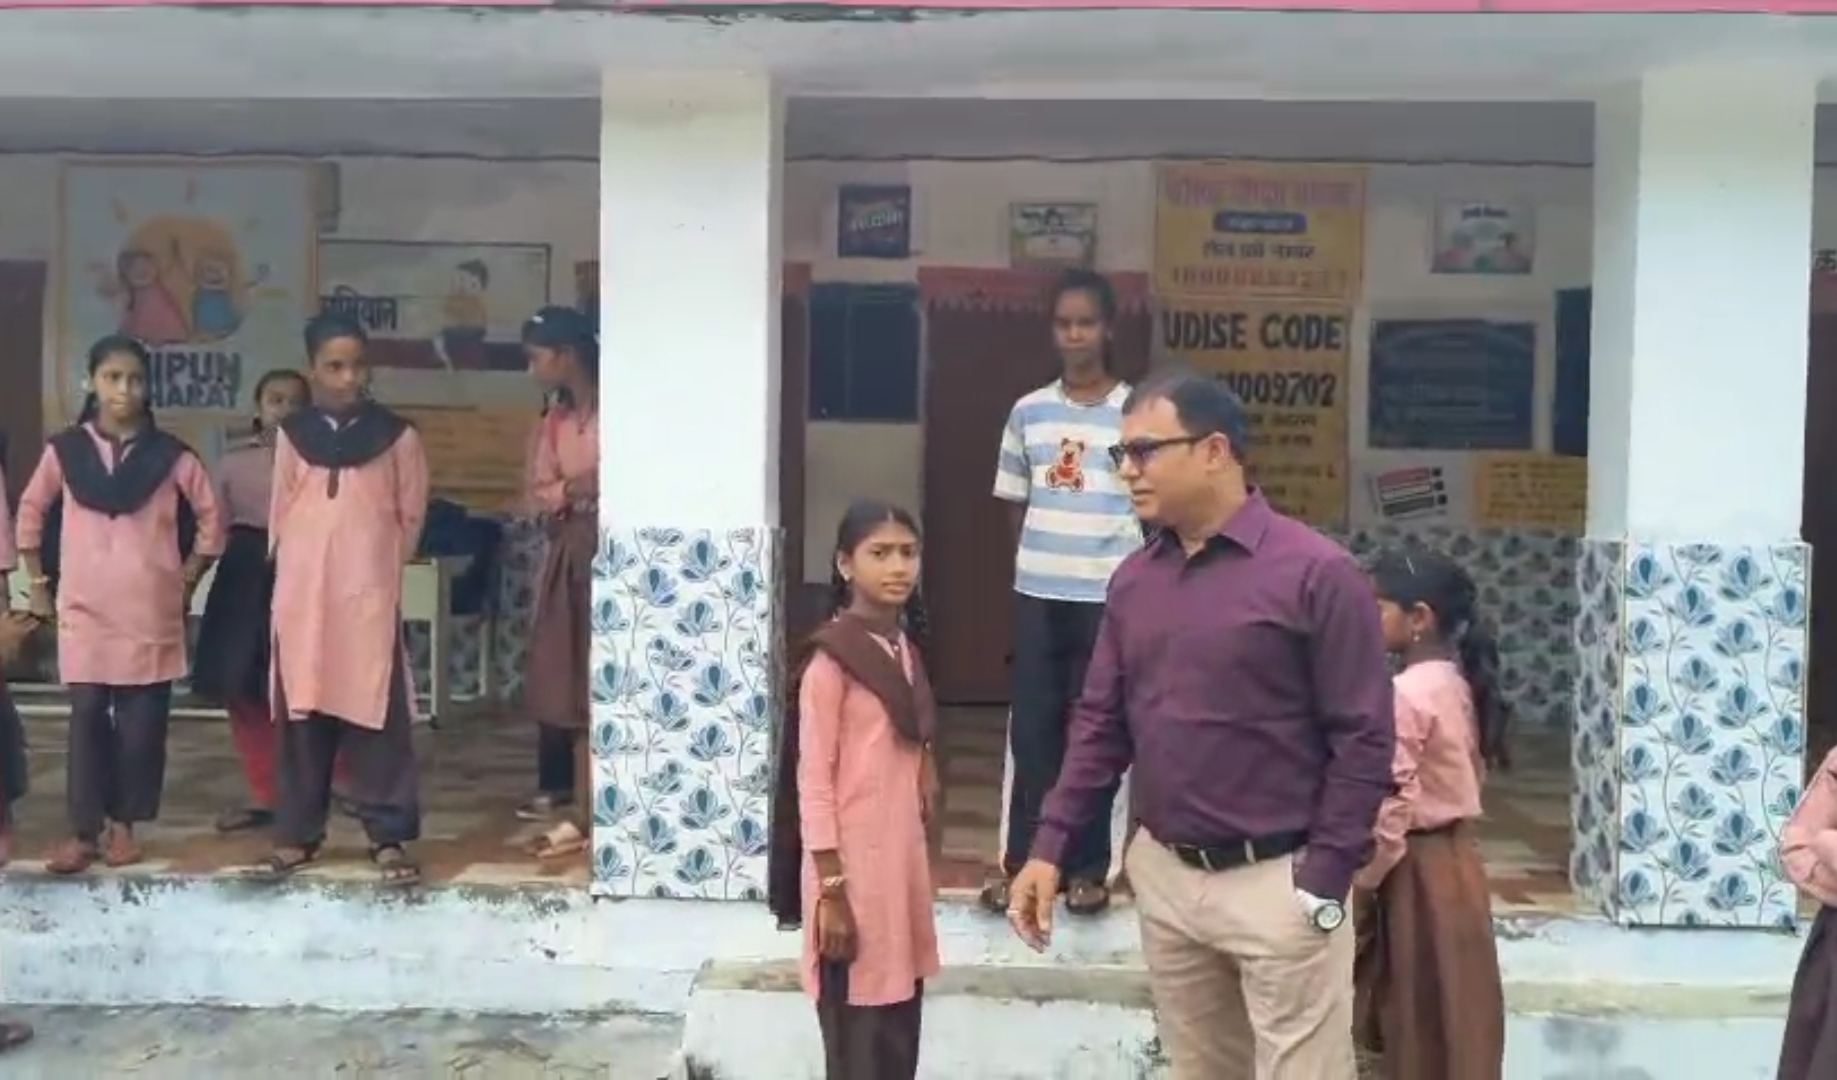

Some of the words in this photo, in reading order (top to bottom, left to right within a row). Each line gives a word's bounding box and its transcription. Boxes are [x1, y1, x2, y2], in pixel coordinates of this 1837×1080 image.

[1163, 310, 1248, 349] UDISE
[1261, 312, 1343, 350] CODE
[147, 384, 236, 408] HARAT
[1217, 371, 1336, 407] 1009702
